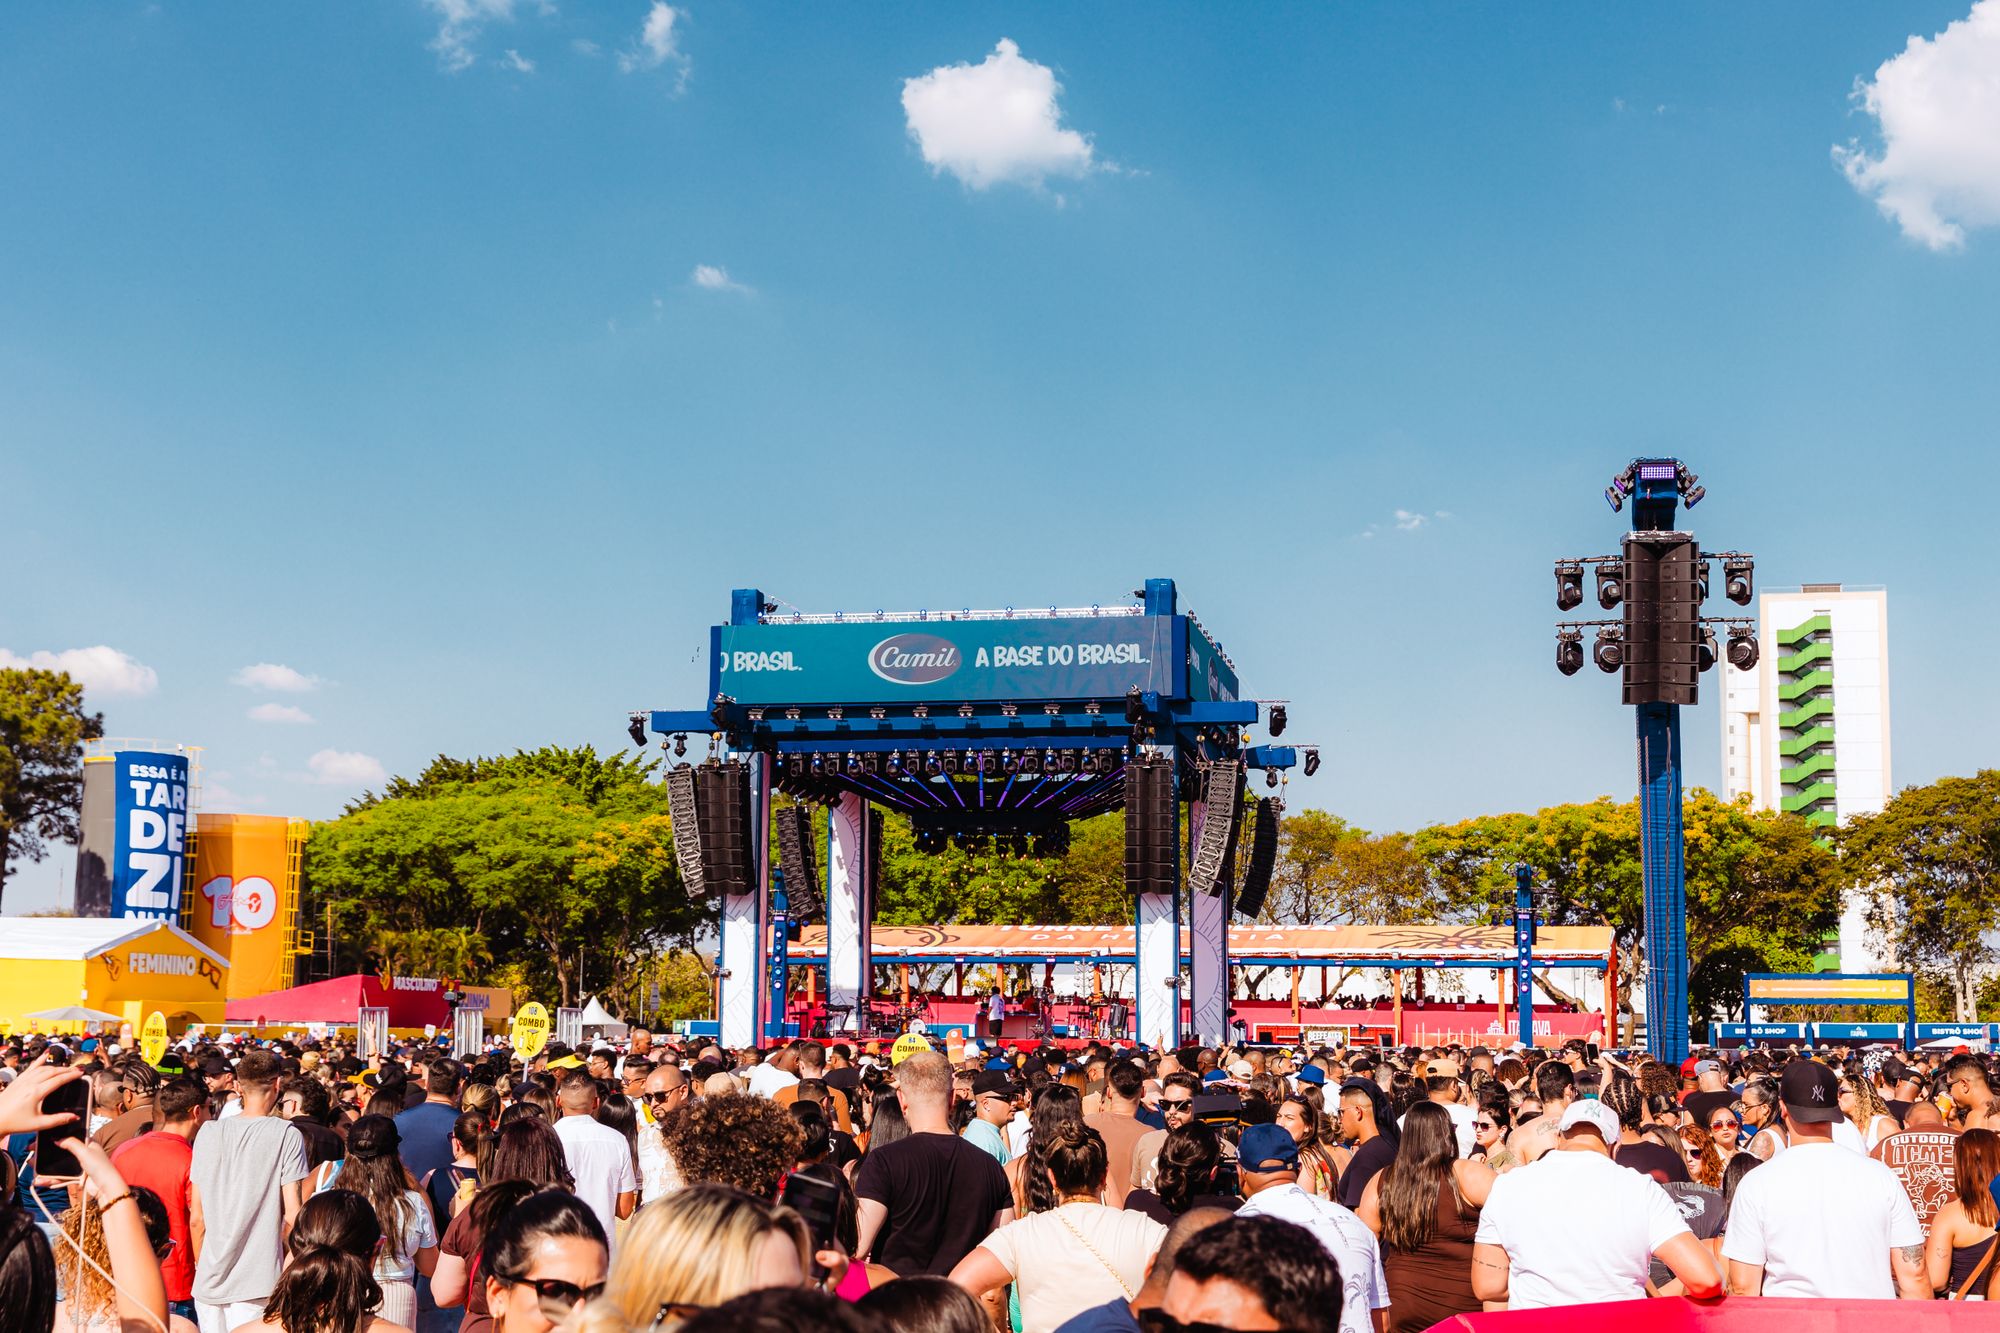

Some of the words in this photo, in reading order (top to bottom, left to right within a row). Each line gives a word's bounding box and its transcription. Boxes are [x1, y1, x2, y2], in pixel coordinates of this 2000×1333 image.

[733, 651, 803, 672] BRASIL.
[880, 646, 956, 668] Camil
[975, 647, 989, 668] A
[994, 645, 1043, 667] BASE
[1050, 645, 1073, 665] DO
[1078, 643, 1151, 665] BRASIL.
[129, 764, 168, 780] ESSA
[170, 766, 177, 781] É
[179, 770, 186, 782] A
[130, 780, 186, 811] TAR
[129, 808, 185, 853] DE
[125, 852, 182, 910] ZI
[202, 875, 277, 930] 10
[129, 952, 196, 976] FEMININO
[393, 976, 437, 992] MASCULINO
[518, 1016, 545, 1028] COMBO
[1765, 1027, 1787, 1035] SHOP
[1931, 1026, 1961, 1035] BISTRÔ
